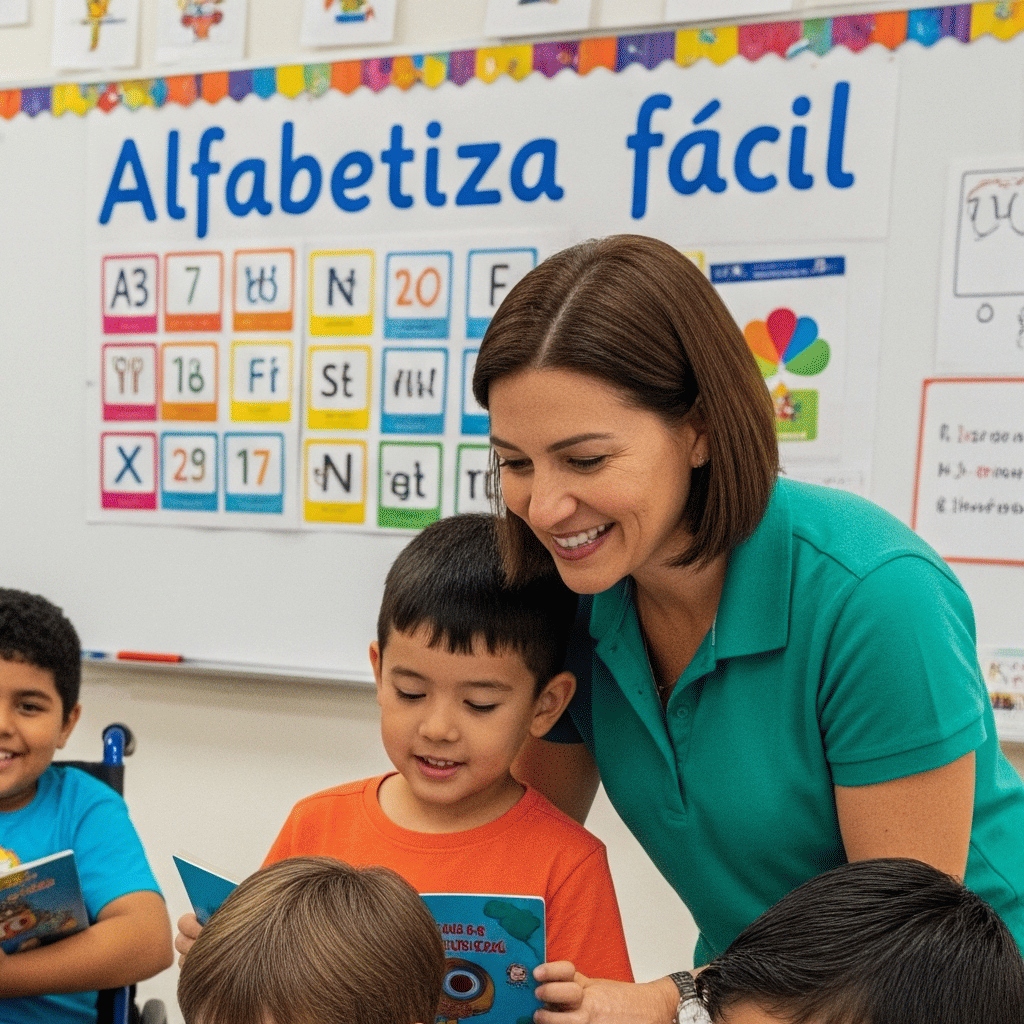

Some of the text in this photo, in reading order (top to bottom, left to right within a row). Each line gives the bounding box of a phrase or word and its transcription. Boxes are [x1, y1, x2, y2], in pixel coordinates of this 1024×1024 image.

[99, 81, 855, 239] Alfabetiza fácil
[110, 267, 149, 309] A3
[184, 265, 200, 305] 7
[394, 266, 442, 308] 20
[489, 263, 510, 307] F
[114, 444, 142, 484] X
[172, 447, 206, 483] 29
[236, 448, 271, 486] 17
